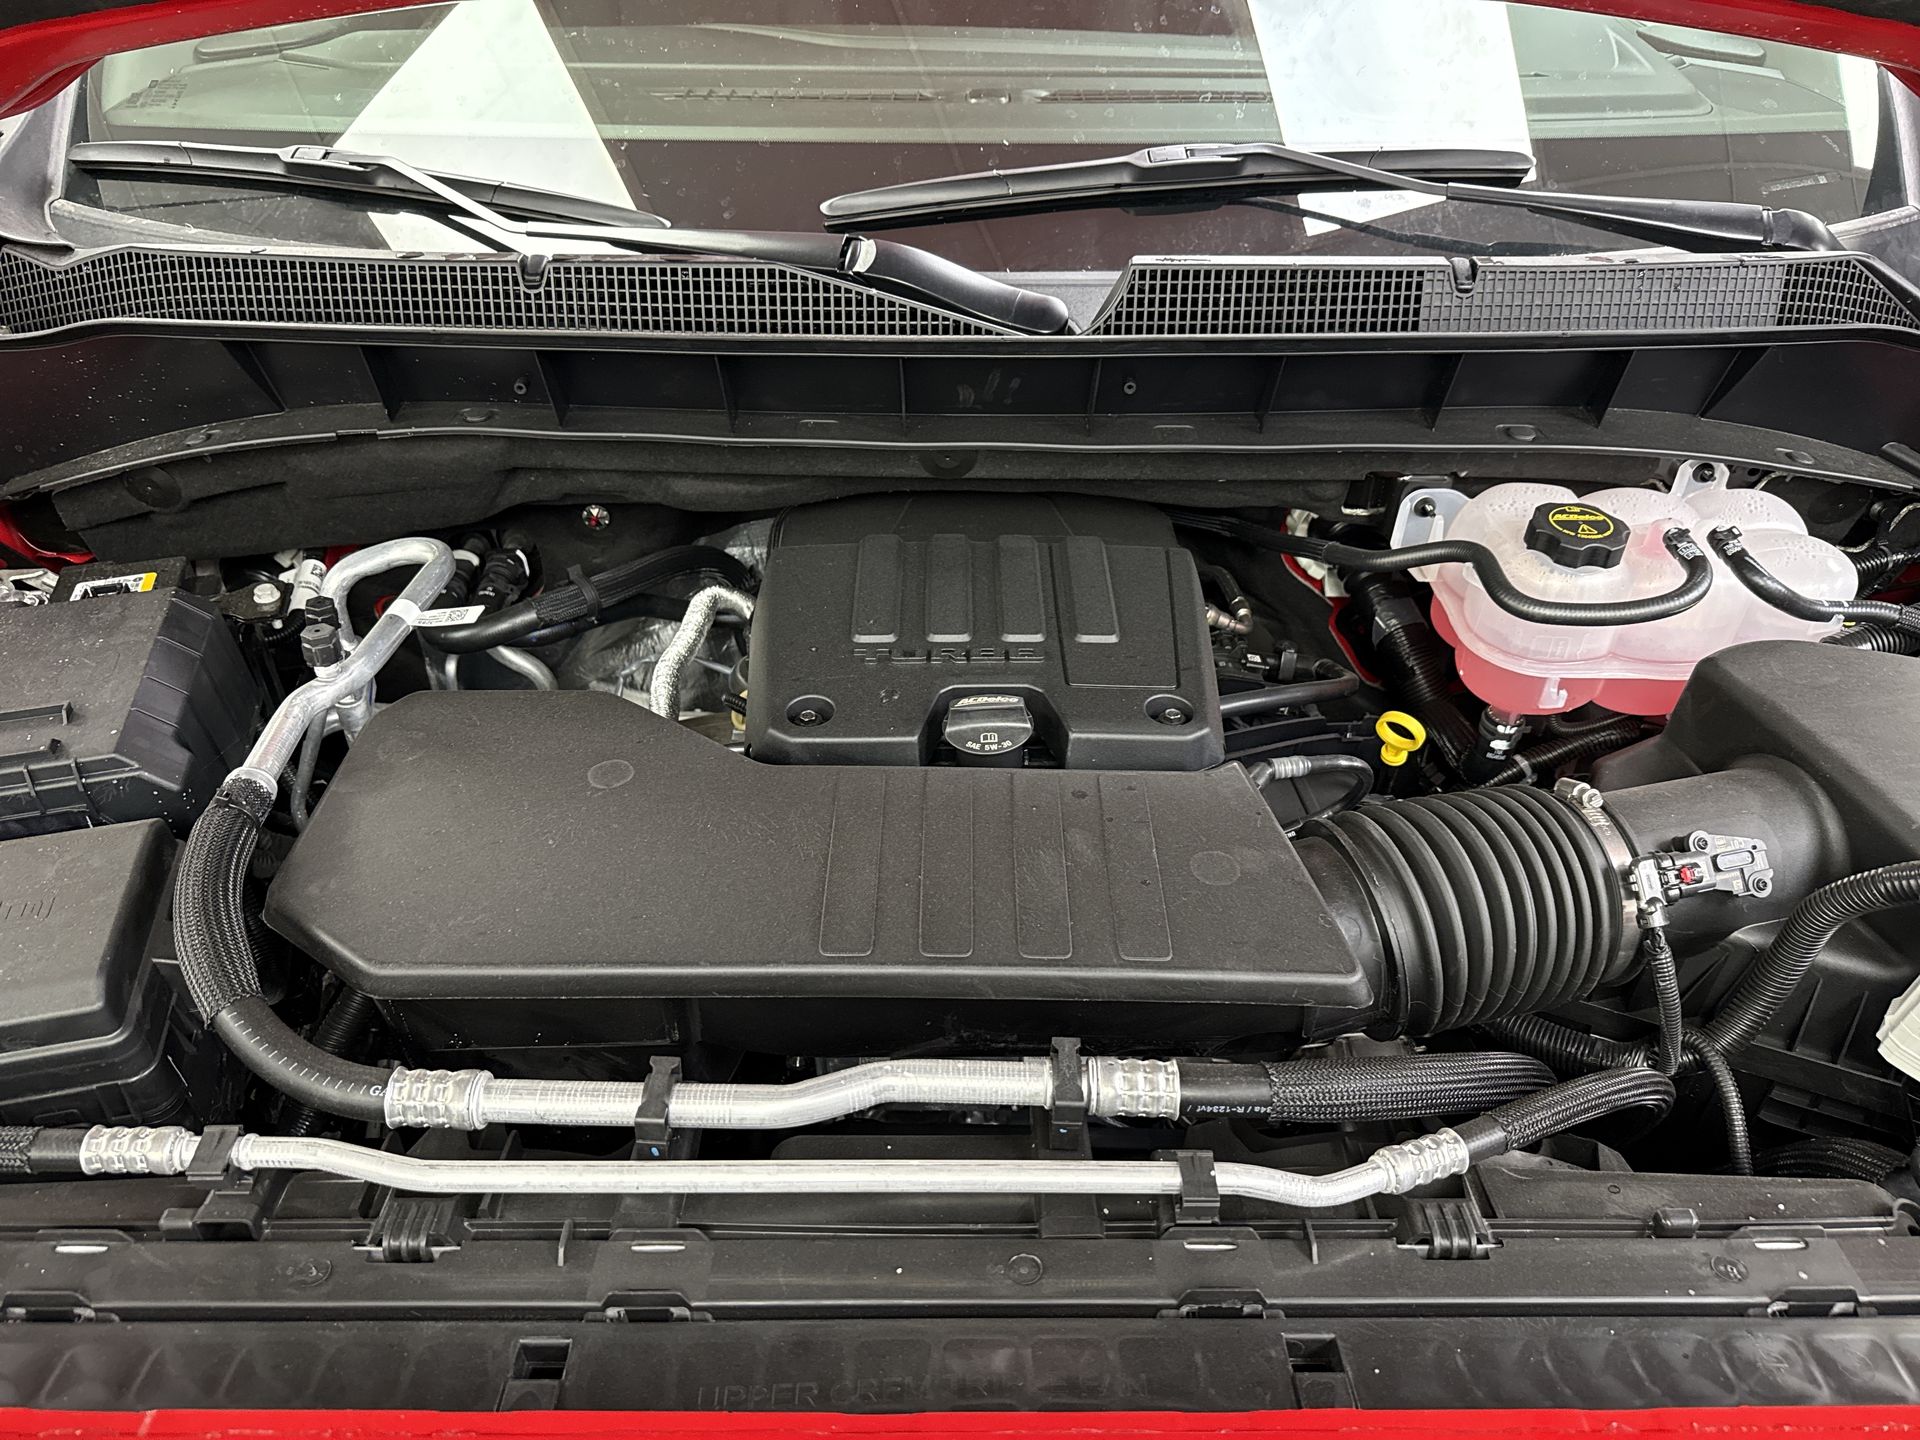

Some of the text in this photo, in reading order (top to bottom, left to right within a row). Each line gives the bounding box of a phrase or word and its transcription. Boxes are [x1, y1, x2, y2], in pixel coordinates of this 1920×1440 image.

[853, 647, 1045, 665] TURBO
[953, 696, 1019, 707] ACDelco
[965, 740, 1013, 751] SAE 5W-30
